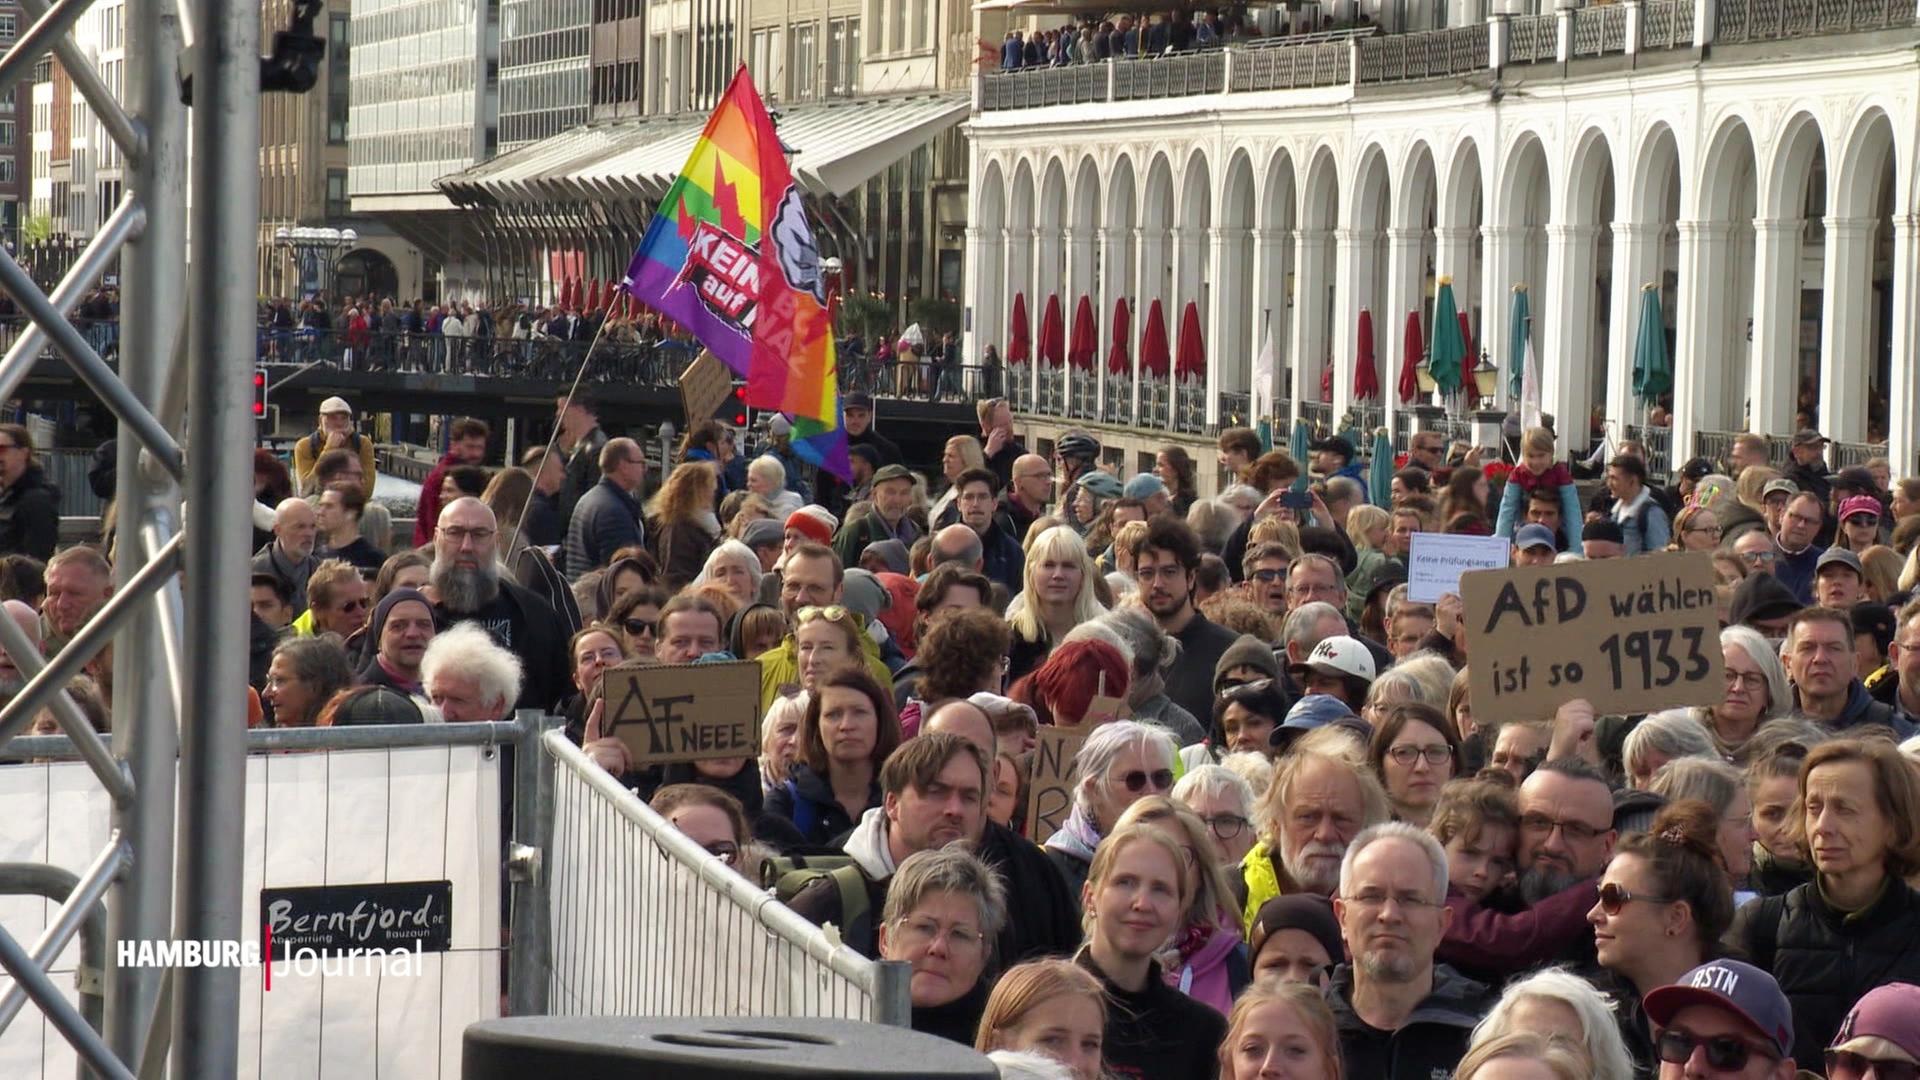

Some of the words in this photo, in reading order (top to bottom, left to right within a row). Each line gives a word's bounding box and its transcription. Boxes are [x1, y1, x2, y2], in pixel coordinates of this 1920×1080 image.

[702, 274, 748, 312] auf
[1484, 577, 1588, 633] AfD
[1610, 577, 1713, 618] wählen
[1492, 656, 1530, 696] ist
[1548, 662, 1583, 687] so
[1600, 627, 1710, 690] 1933
[1035, 786, 1070, 842] R
[268, 894, 433, 941] Bernfjord
[386, 930, 430, 939] Bauzaun
[1691, 966, 1739, 996] ASTN
